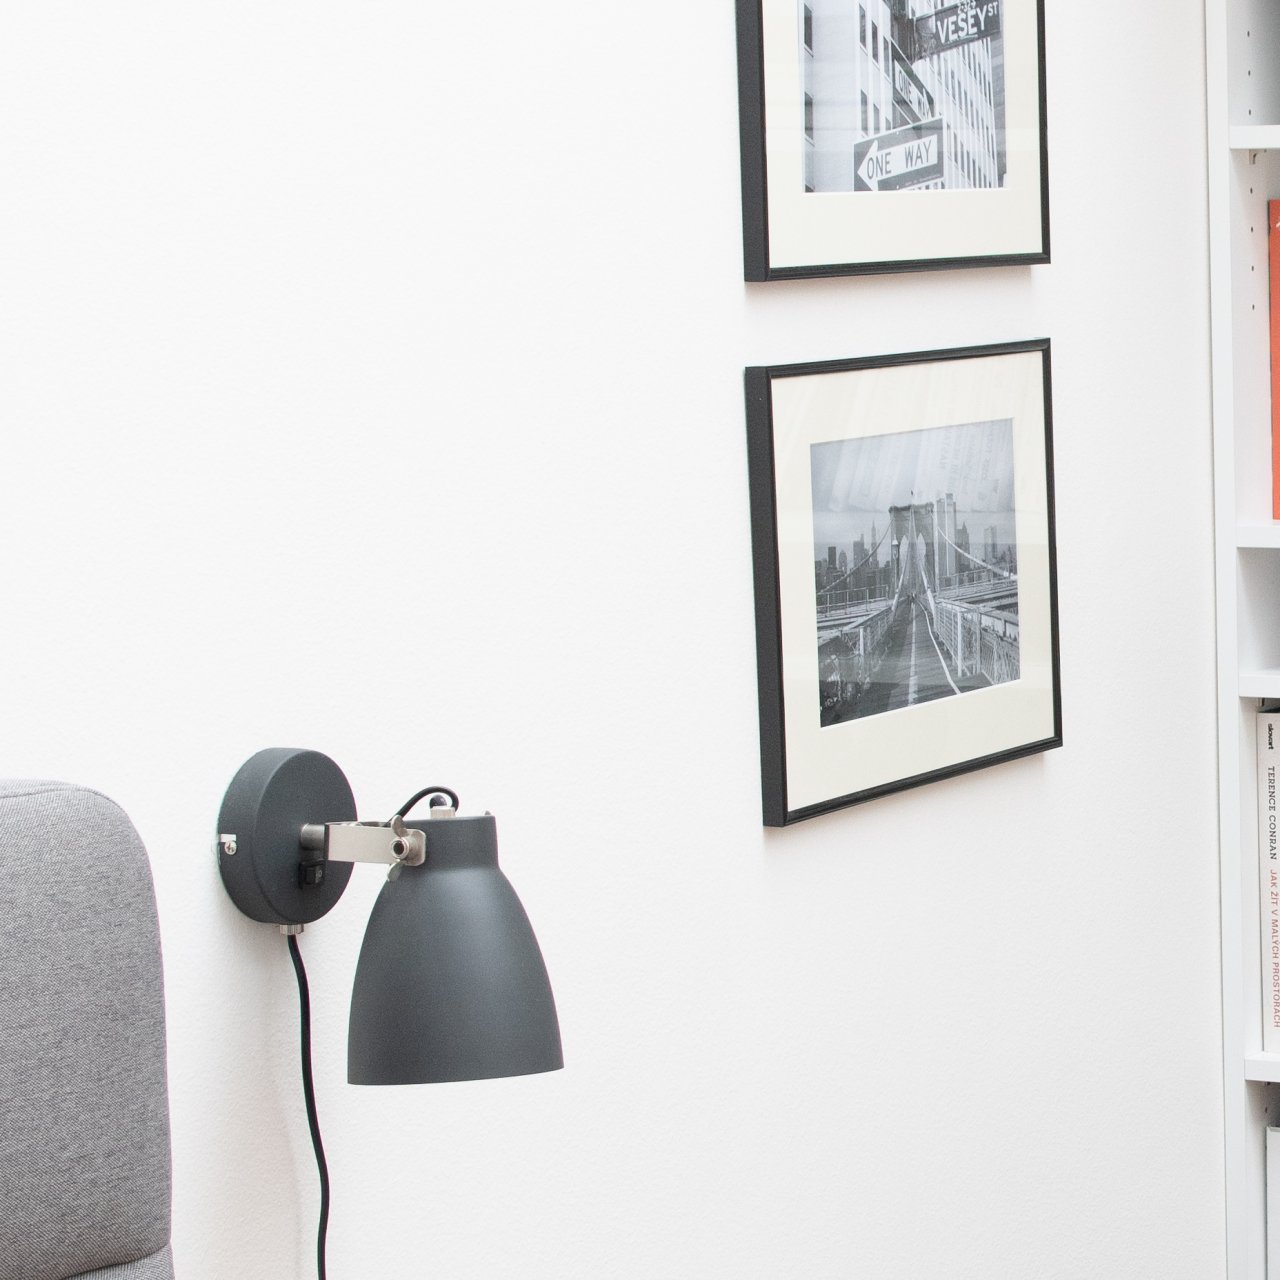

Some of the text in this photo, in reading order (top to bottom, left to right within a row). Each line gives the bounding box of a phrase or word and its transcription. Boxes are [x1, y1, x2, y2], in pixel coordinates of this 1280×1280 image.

[937, 1, 999, 44] VESEY ST
[898, 69, 913, 105] ONE
[866, 151, 892, 181] ONE
[904, 140, 932, 169] WAY
[1268, 766, 1277, 860] TERENCE CONRAN
[1270, 869, 1279, 889] JAK
[1270, 890, 1280, 907] ŽÍT
[1271, 920, 1280, 960] MALÝCH
[1272, 960, 1280, 1028] PROSTORÁCH
